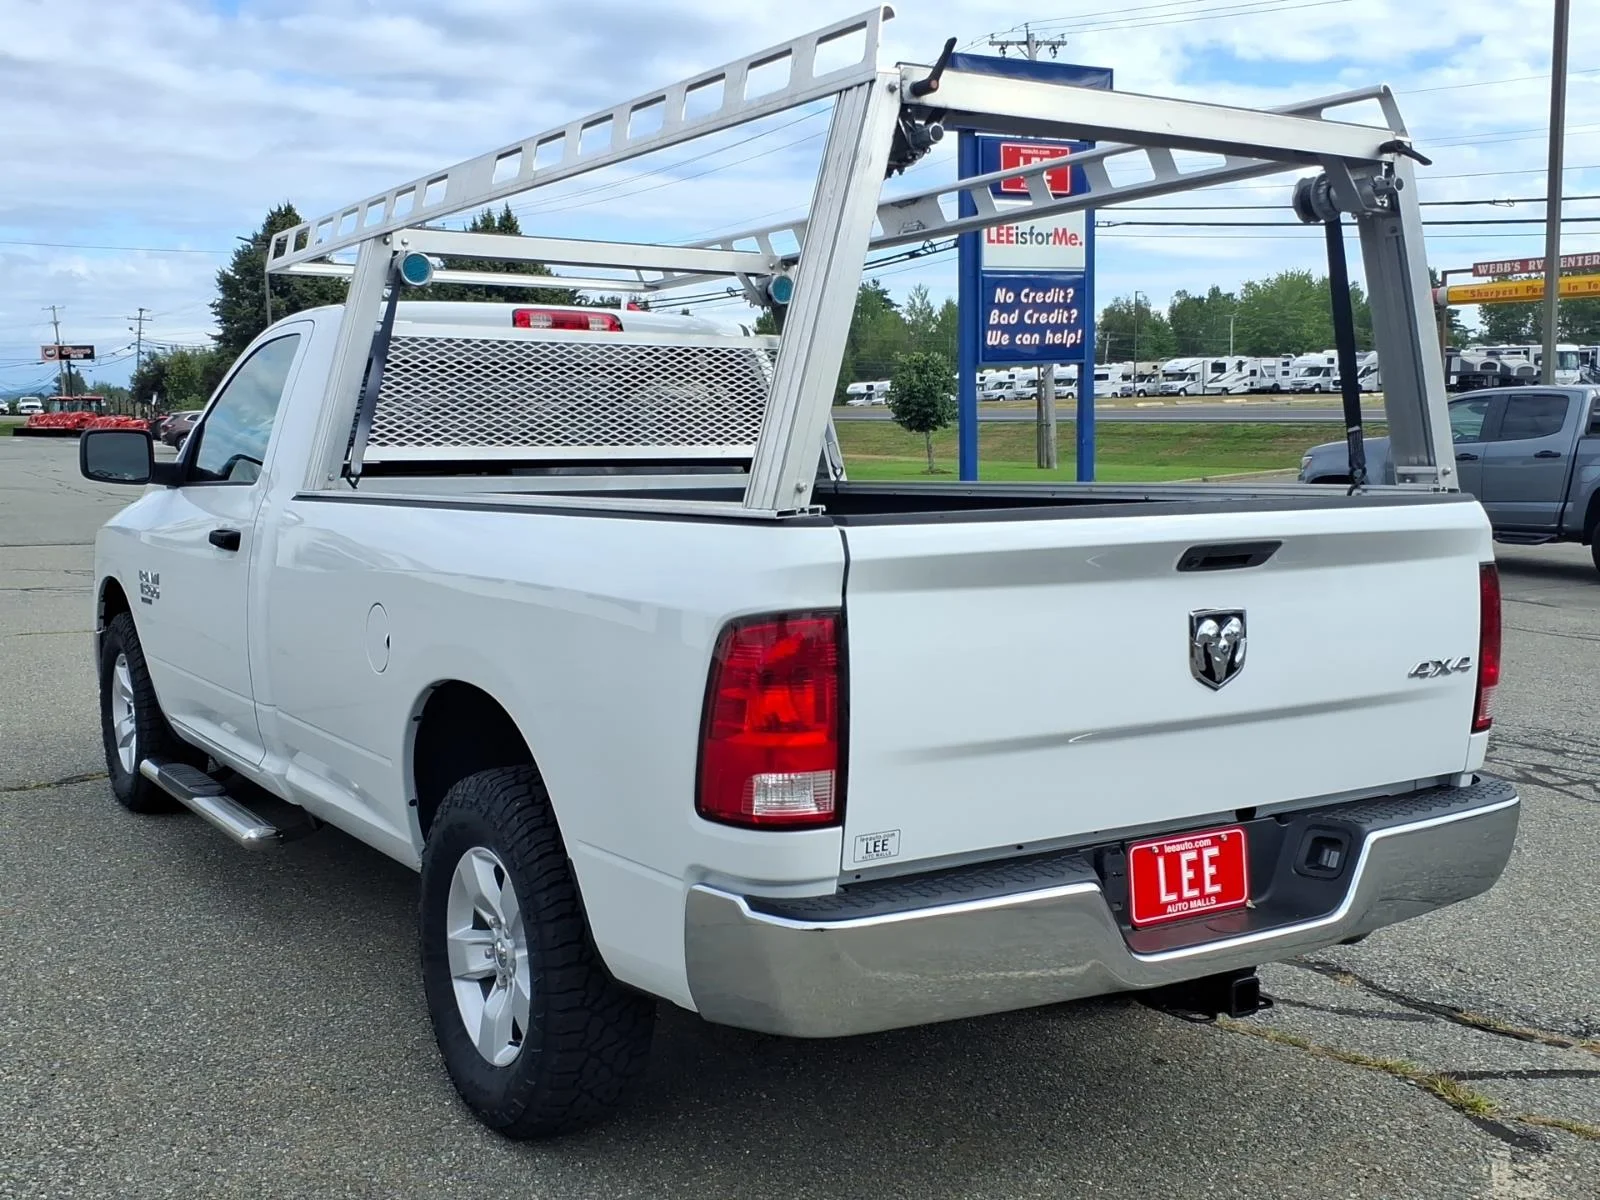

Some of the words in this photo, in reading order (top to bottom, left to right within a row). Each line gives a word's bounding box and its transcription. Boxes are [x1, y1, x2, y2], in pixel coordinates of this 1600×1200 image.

[986, 224, 1083, 246] LEEisforMe.
[1477, 261, 1521, 275] WEBB'S
[1528, 259, 1545, 271] RV
[1560, 254, 1600, 268] ENTER
[994, 287, 1015, 304] No
[1020, 287, 1074, 304] Credit?
[989, 308, 1019, 325] Bad
[1024, 308, 1078, 324] Credit?
[986, 329, 1010, 346] We
[1015, 333, 1040, 345] can
[1044, 328, 1082, 348] help!
[865, 838, 889, 854] LEE
[1164, 838, 1212, 854] leeauto.com
[1158, 846, 1222, 904] LEE
[1166, 901, 1189, 914] AUTO
[1189, 896, 1217, 910] MALLS
